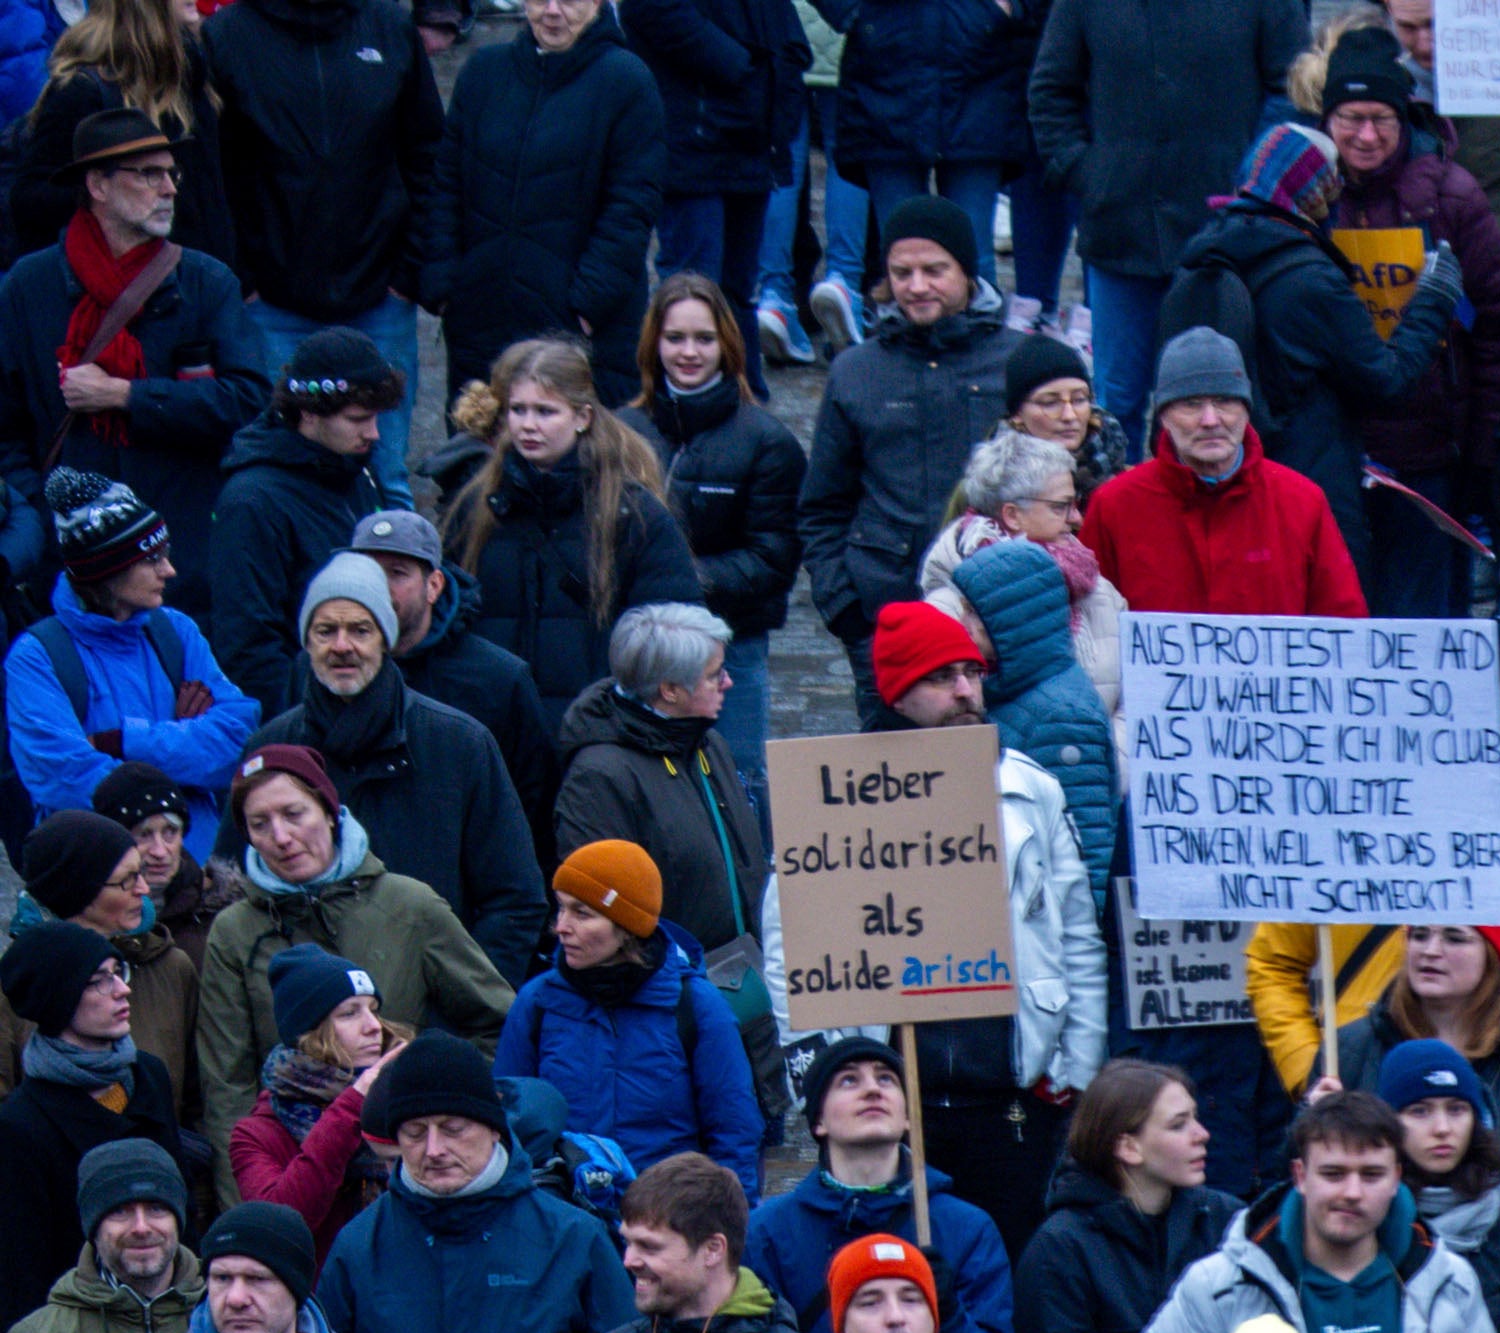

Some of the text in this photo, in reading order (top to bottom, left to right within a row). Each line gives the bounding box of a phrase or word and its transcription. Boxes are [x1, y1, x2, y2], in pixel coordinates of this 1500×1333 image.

[1444, 61, 1485, 79] NUR
[1131, 622, 1185, 666] AUS
[1190, 623, 1353, 669] PROTEST
[1369, 629, 1418, 670] DIE
[1165, 673, 1206, 712] ZU
[1215, 672, 1333, 715] WÄHLEN
[1345, 677, 1397, 716] IST
[1135, 716, 1192, 760] ALS
[1207, 716, 1325, 764] WÜRDE
[1337, 725, 1381, 763] ICH
[1396, 726, 1423, 765] IM
[820, 761, 945, 806] Lieber
[1143, 771, 1413, 816] AUS DER TOILETTE
[783, 823, 997, 875] solidarisch
[1261, 829, 1323, 868] WEIL
[1335, 829, 1379, 866] MIR
[1386, 832, 1436, 867] DAS
[861, 891, 924, 936] als
[1218, 873, 1303, 911] NICHT
[788, 948, 1010, 995] solide arisch
[1135, 953, 1231, 985] ist keine
